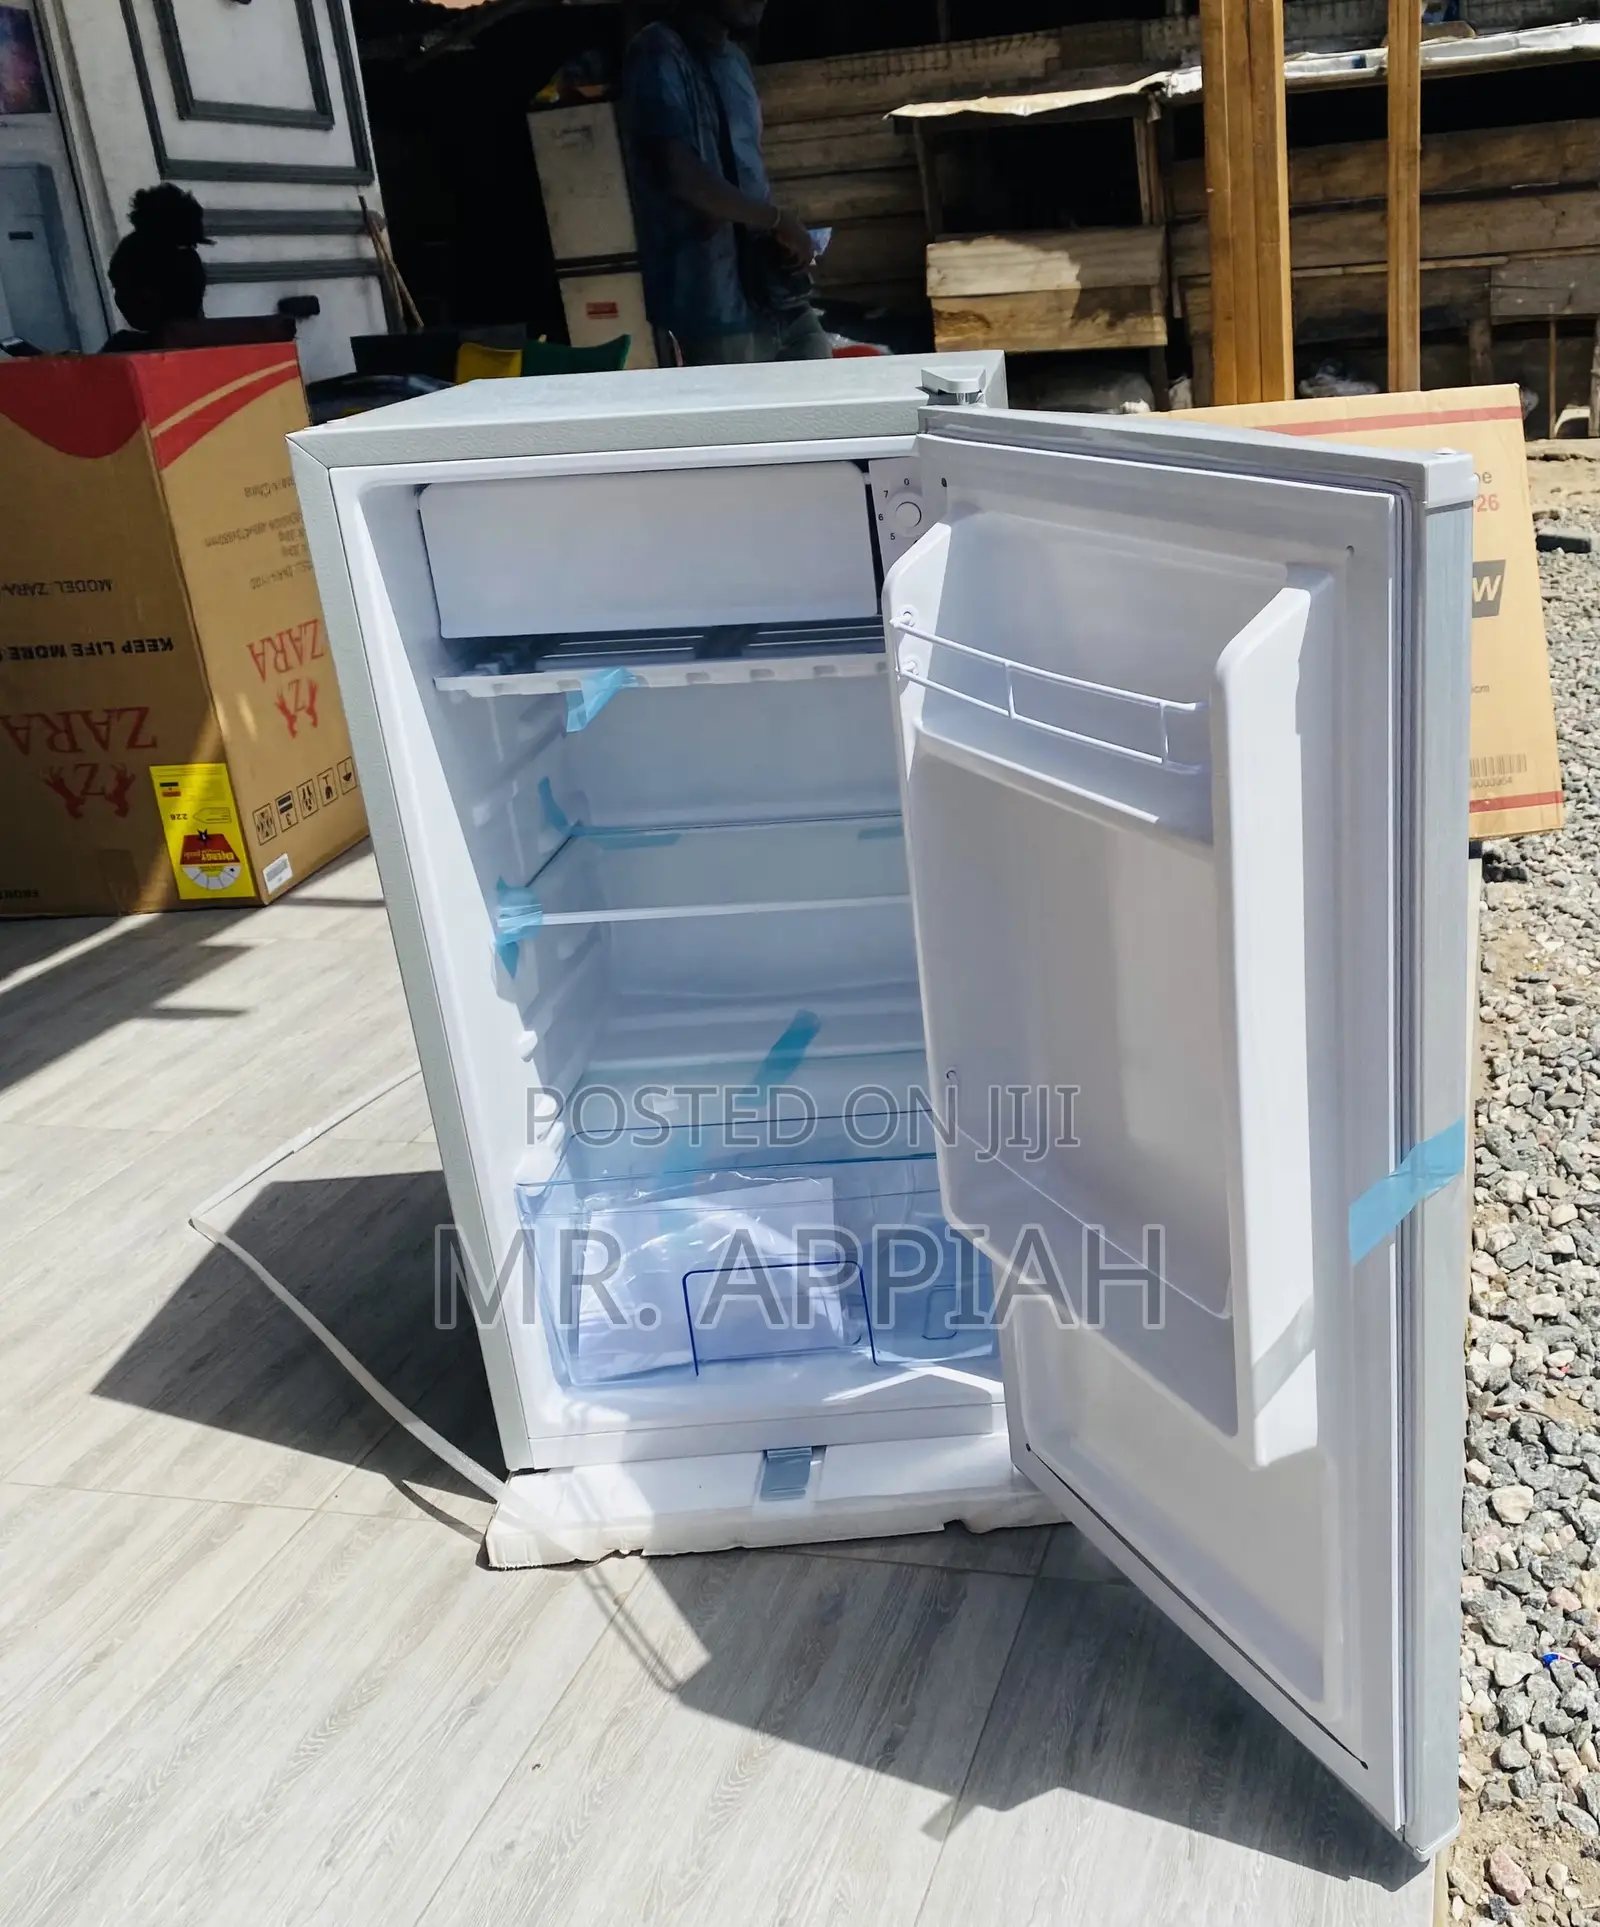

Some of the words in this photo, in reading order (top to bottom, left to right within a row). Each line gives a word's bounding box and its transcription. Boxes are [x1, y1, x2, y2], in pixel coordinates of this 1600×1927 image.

[883, 489, 889, 498] 7
[890, 532, 896, 541] 5
[1472, 574, 1502, 602] W
[9, 645, 68, 661] MORE
[73, 641, 114, 657] LIFE
[121, 637, 174, 653] KEEP
[246, 618, 324, 683] ZARA
[0, 706, 157, 756] ZARA
[170, 813, 188, 821] 226
